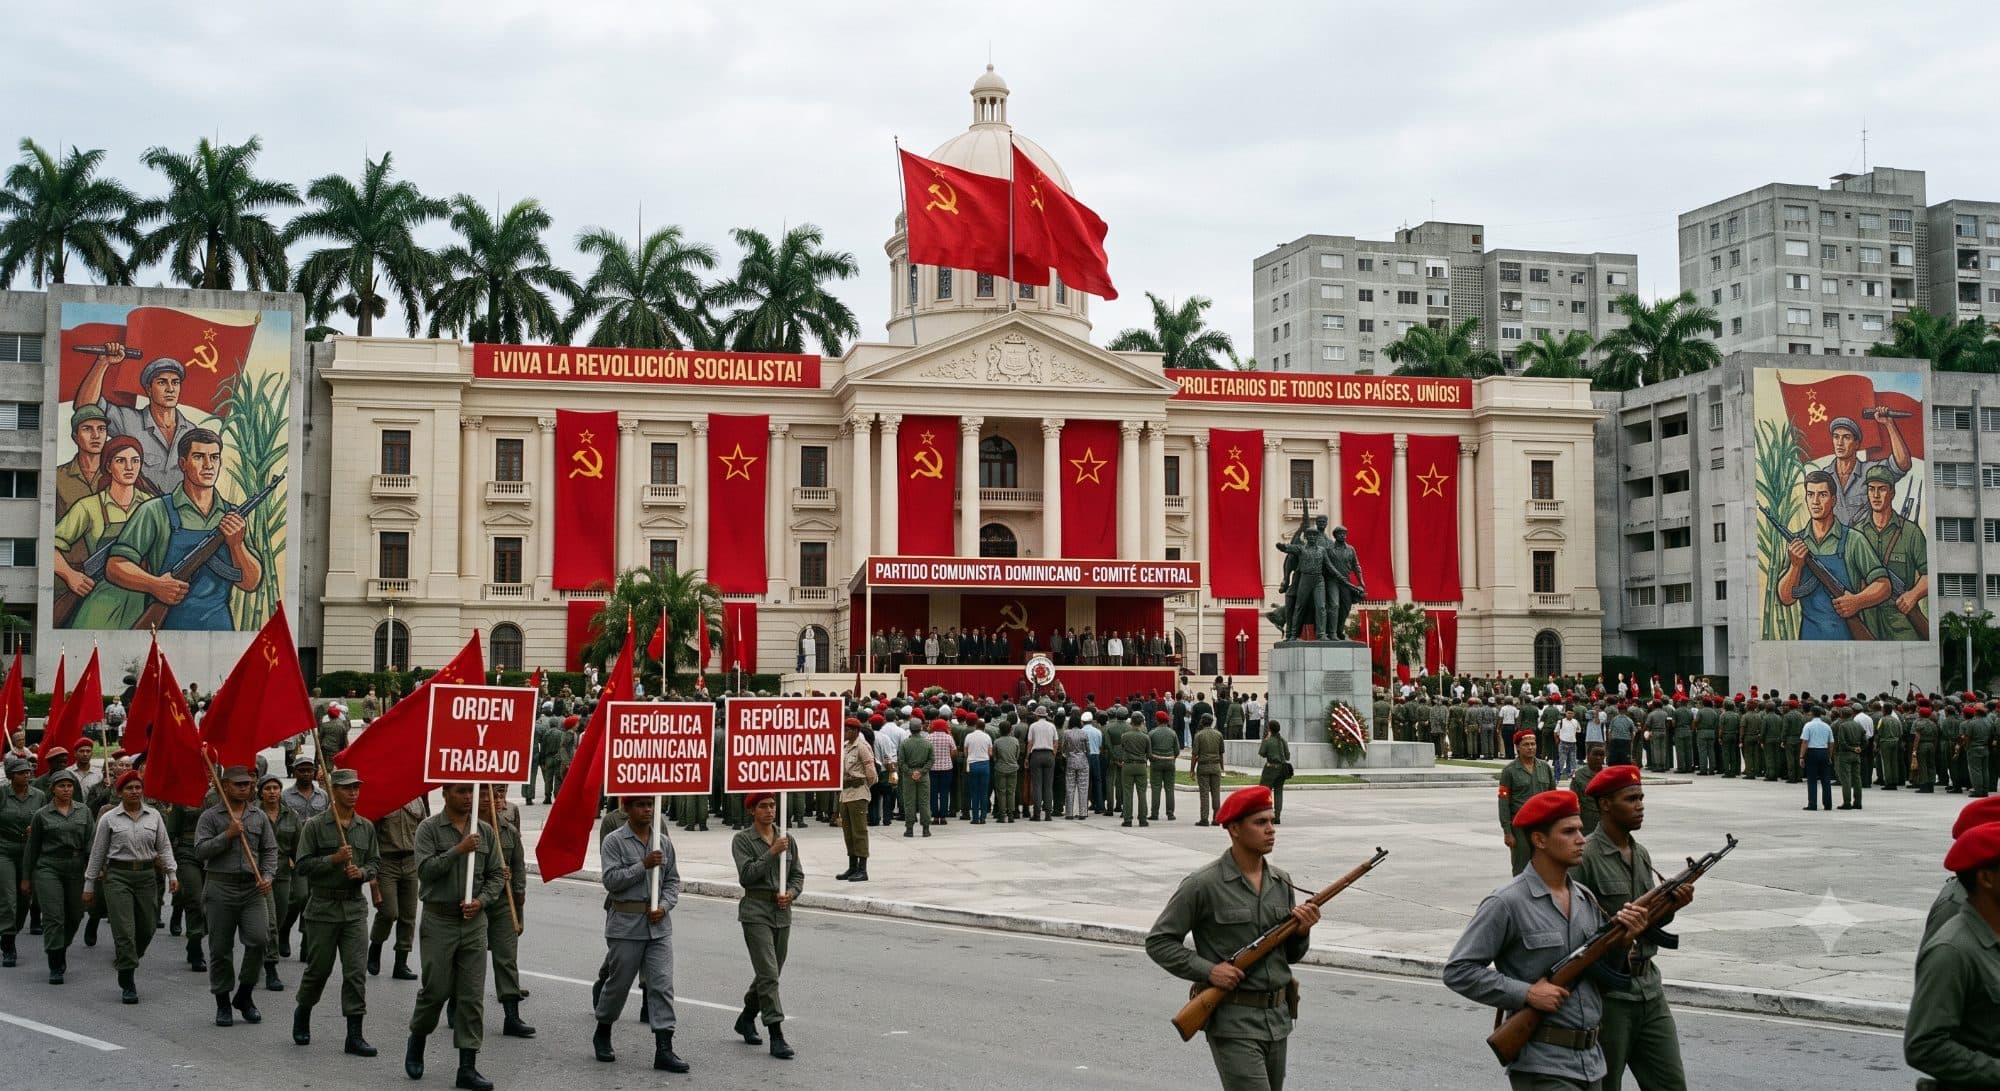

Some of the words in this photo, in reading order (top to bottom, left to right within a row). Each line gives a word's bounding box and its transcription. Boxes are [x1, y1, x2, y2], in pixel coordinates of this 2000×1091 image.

[494, 352, 541, 373] ¡VIVA
[548, 353, 569, 374] LA
[576, 352, 688, 378] REVOLUCIÓN
[695, 357, 802, 381] SOCIALISTA!
[1177, 377, 1266, 396] PROLETARIOS
[1271, 380, 1287, 396] DE
[1291, 381, 1332, 398] TODOS
[1338, 382, 1361, 399] LOS
[1365, 380, 1413, 402] PAÍSES,
[1418, 382, 1459, 402] UNÍOS!
[875, 563, 928, 580] PARTIDO
[931, 564, 1002, 581] COMUNISTA
[1005, 565, 1081, 582] DOMINICANO
[1093, 564, 1136, 582] COMITÉ
[1140, 567, 1194, 583] CENTRAL
[453, 697, 514, 721] ORDEN
[741, 704, 829, 729] REPÚBLICA
[621, 711, 701, 734] REPÚBLICA
[476, 724, 489, 747] Y
[734, 734, 835, 756] DOMINICANA
[613, 739, 707, 758] DOMINICANA
[439, 749, 519, 773] TRABAJO
[739, 760, 829, 782] SOCIALISTA
[617, 764, 700, 783] SOCIALISTA
